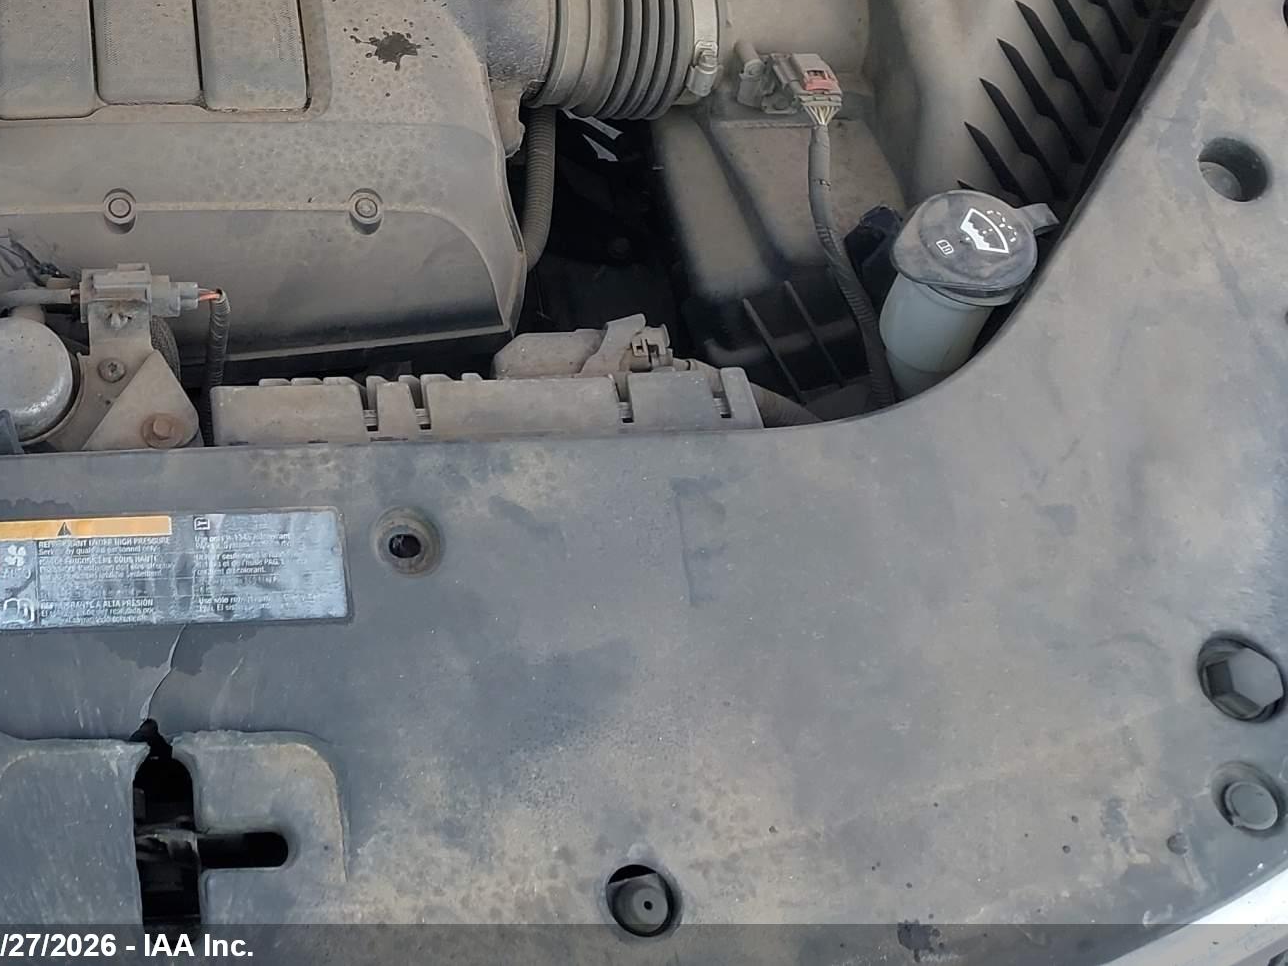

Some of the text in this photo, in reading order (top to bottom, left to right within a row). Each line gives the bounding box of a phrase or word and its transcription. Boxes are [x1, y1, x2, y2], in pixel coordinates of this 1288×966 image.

[114, 537, 132, 546] HIGH
[133, 536, 171, 545] PRESSURE
[103, 599, 121, 608] ALTA
